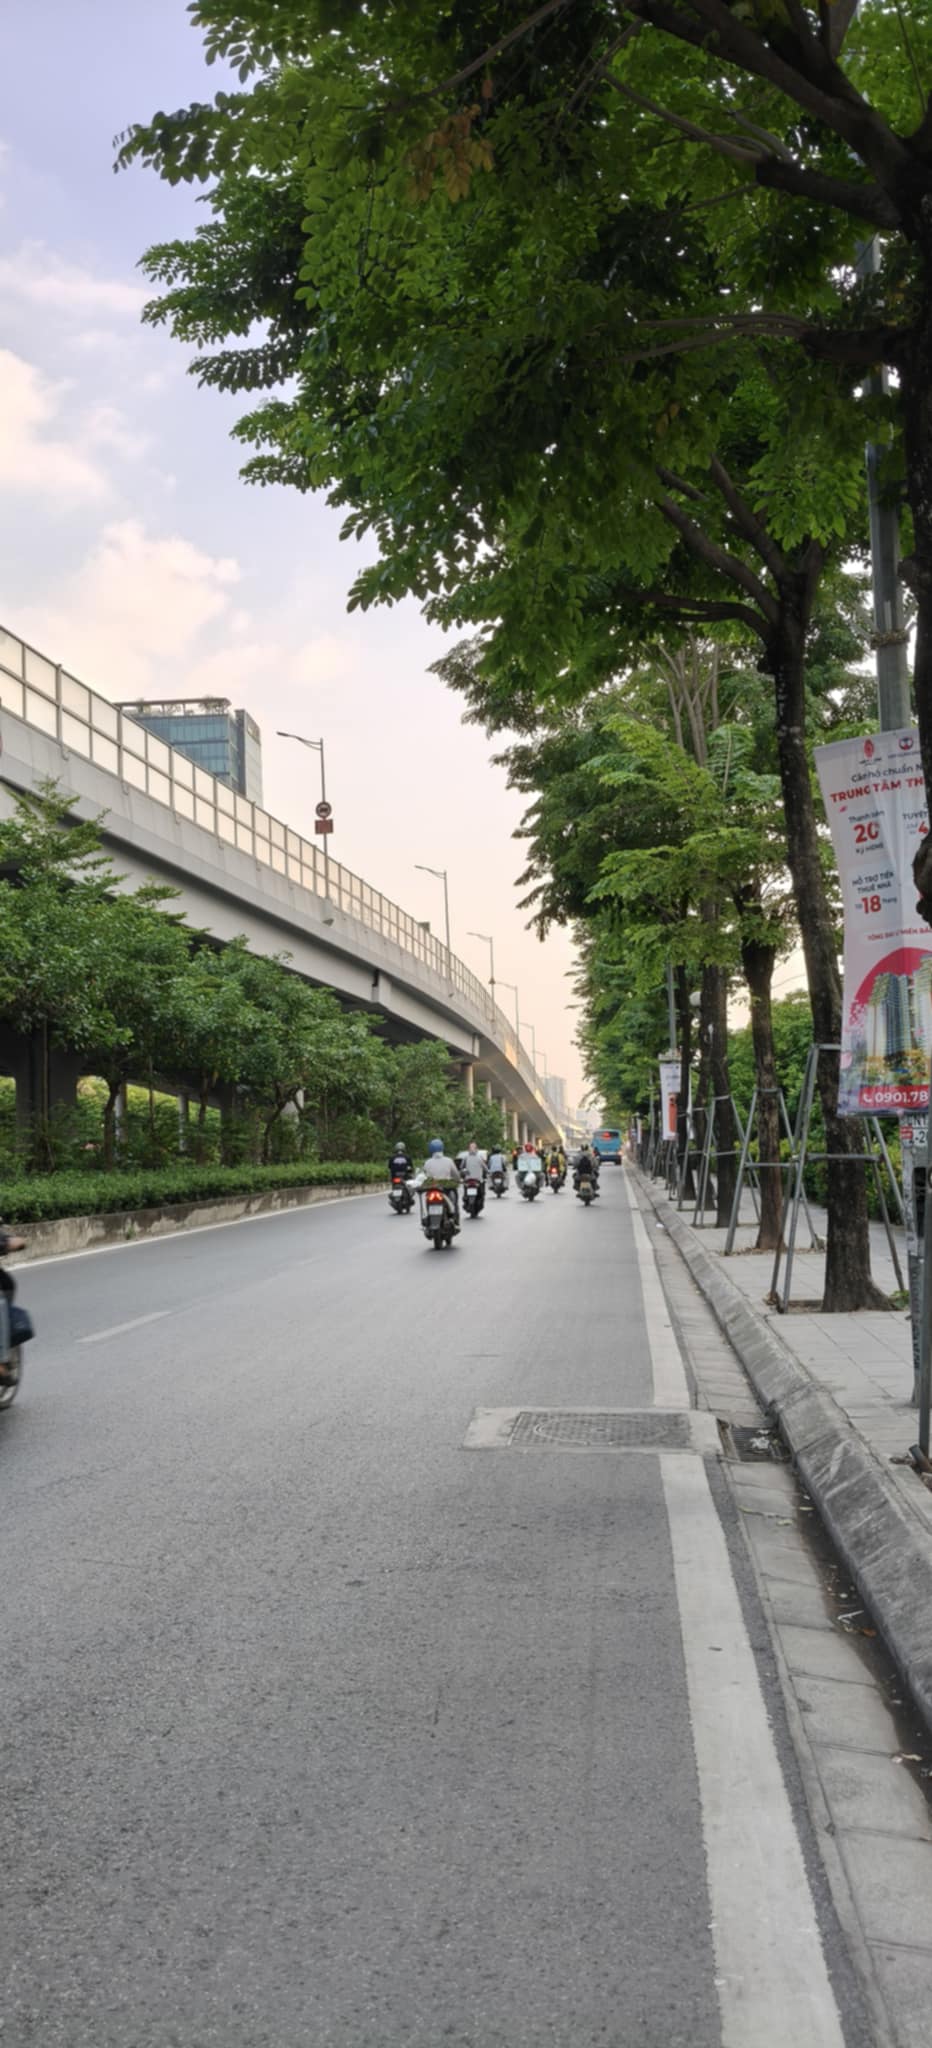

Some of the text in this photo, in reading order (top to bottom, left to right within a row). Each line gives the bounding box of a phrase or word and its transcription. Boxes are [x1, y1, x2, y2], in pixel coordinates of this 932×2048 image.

[830, 785, 871, 802] TRUNG
[873, 779, 901, 792] TÂM
[861, 895, 881, 914] 18
[874, 1091, 928, 1103] 0901.78
